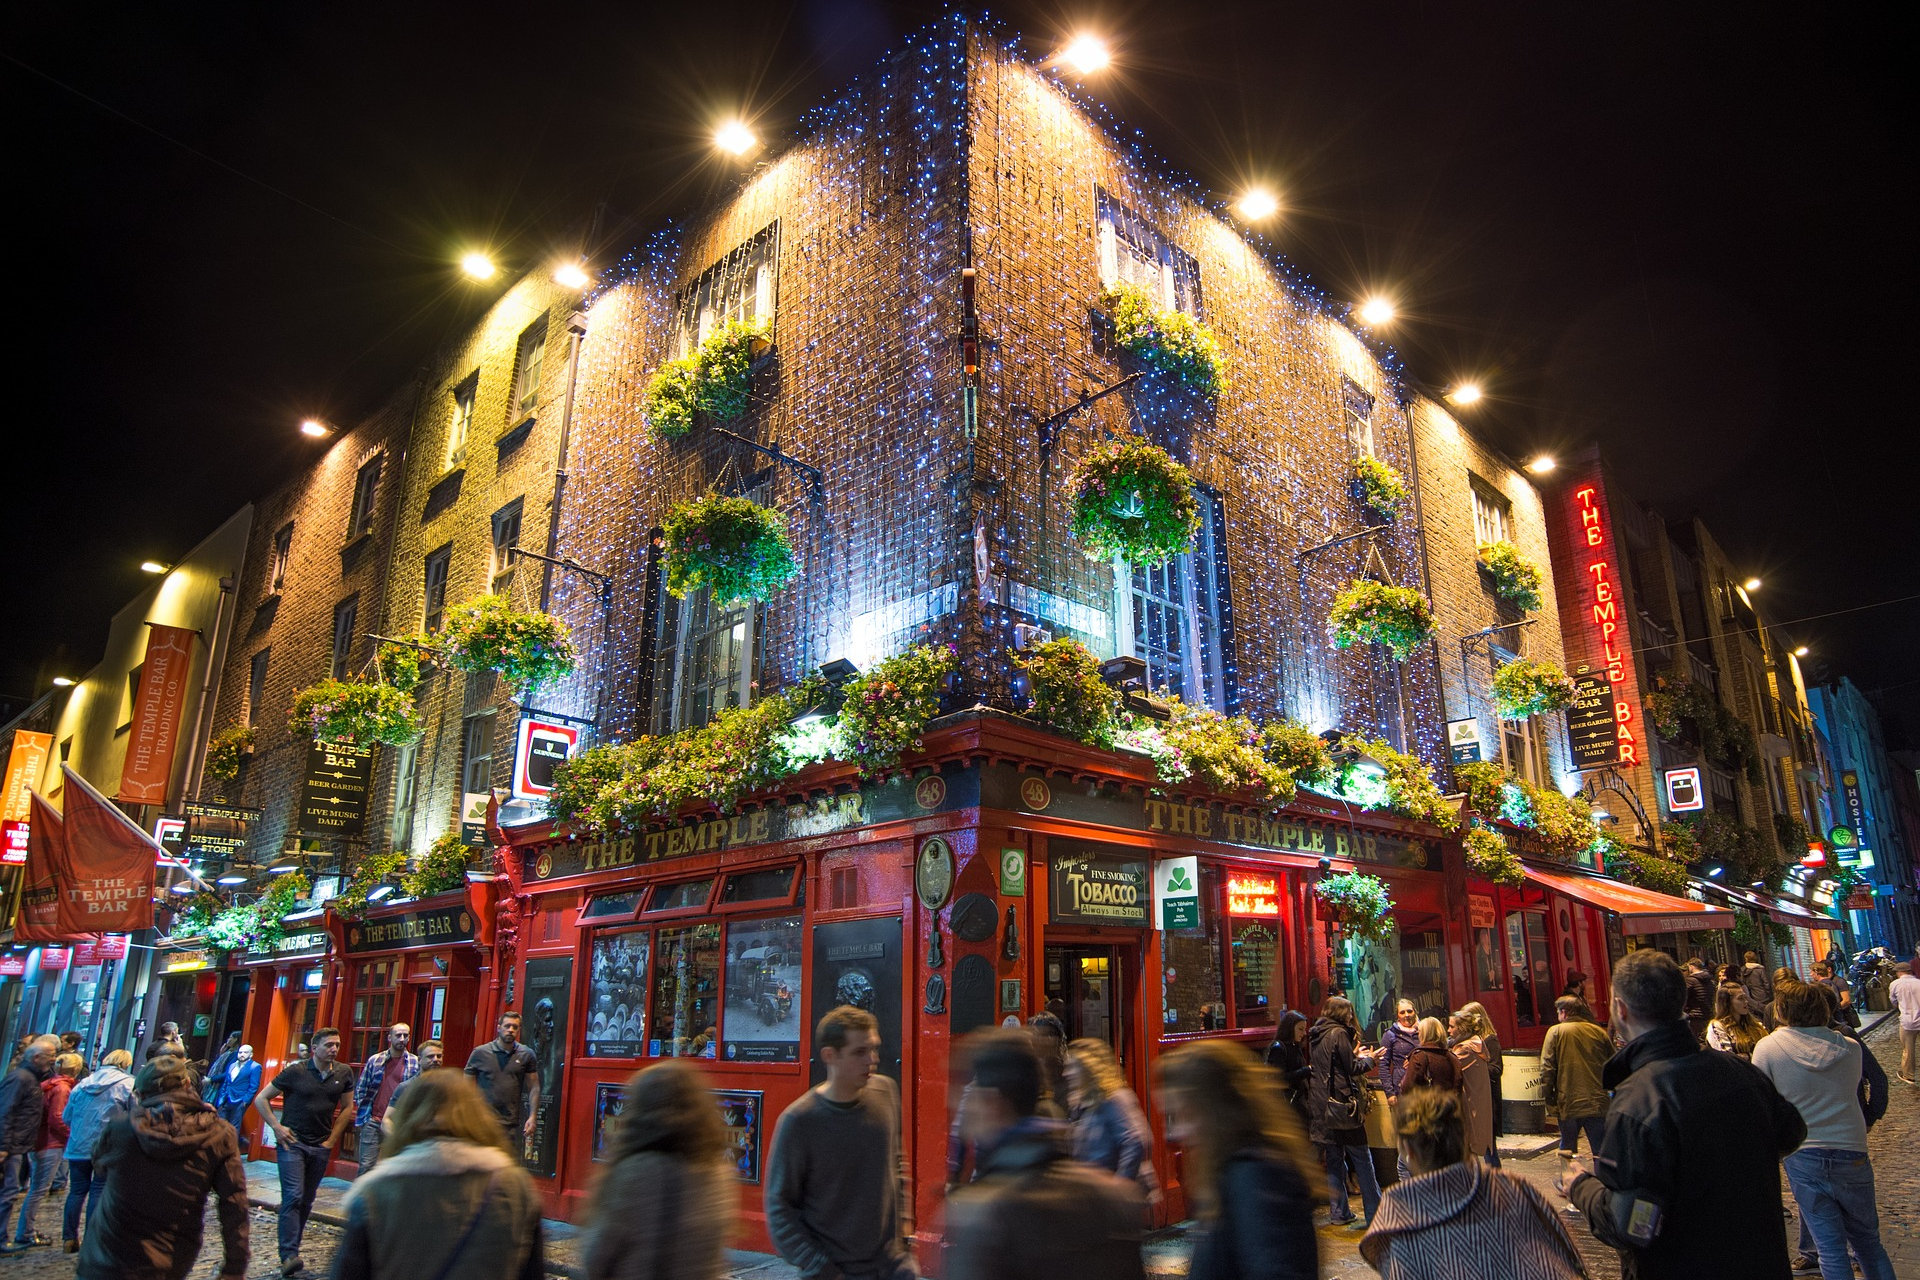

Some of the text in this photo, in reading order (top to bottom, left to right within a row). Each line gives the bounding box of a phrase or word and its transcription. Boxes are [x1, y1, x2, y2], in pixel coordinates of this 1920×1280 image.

[1010, 597, 1039, 612] EMPLE
[1577, 488, 1637, 763] THE TEMPLE BAR
[1576, 686, 1611, 699] EMPLE
[1578, 681, 1594, 689] THE
[1577, 698, 1602, 709] BAR
[134, 656, 169, 774] THE TEMPLE BAR
[155, 679, 179, 755] TRADING CO.
[1570, 717, 1613, 730] BEER GARDEN
[1574, 740, 1614, 752] LIVE MUSIC
[1584, 748, 1606, 757] DAILY
[25, 754, 40, 777] THE
[324, 753, 356, 768] BAR
[6, 767, 22, 809] TRADING
[308, 779, 365, 792] BEER GARDEN
[920, 782, 940, 802] 48
[1026, 781, 1044, 802] 48
[186, 806, 261, 821] THE TEMPLE BAR
[307, 807, 359, 819] LIVE MUSIC
[1847, 788, 1866, 847] HOSTEL
[318, 818, 346, 826] DAILY
[1145, 799, 1379, 861] THE TEMPLE BAR
[190, 834, 248, 847] DISTILLERY
[582, 838, 636, 870] THE
[645, 810, 770, 860] TEMPLE
[201, 844, 234, 854] STORE
[1055, 851, 1096, 873] Importers
[92, 878, 126, 889] THE
[1091, 870, 1137, 882] FINE SMOKING
[68, 886, 148, 902] TEMPLE
[1066, 873, 1137, 910] TOBACCO
[26, 894, 58, 906] TEMP
[87, 901, 129, 914] BAR
[1082, 905, 1110, 915] Always
[1122, 907, 1143, 917] Stock
[365, 915, 452, 943] THE TEMPLE BAR
[1240, 924, 1263, 940] TEMPLE
[1424, 932, 1438, 949] THE
